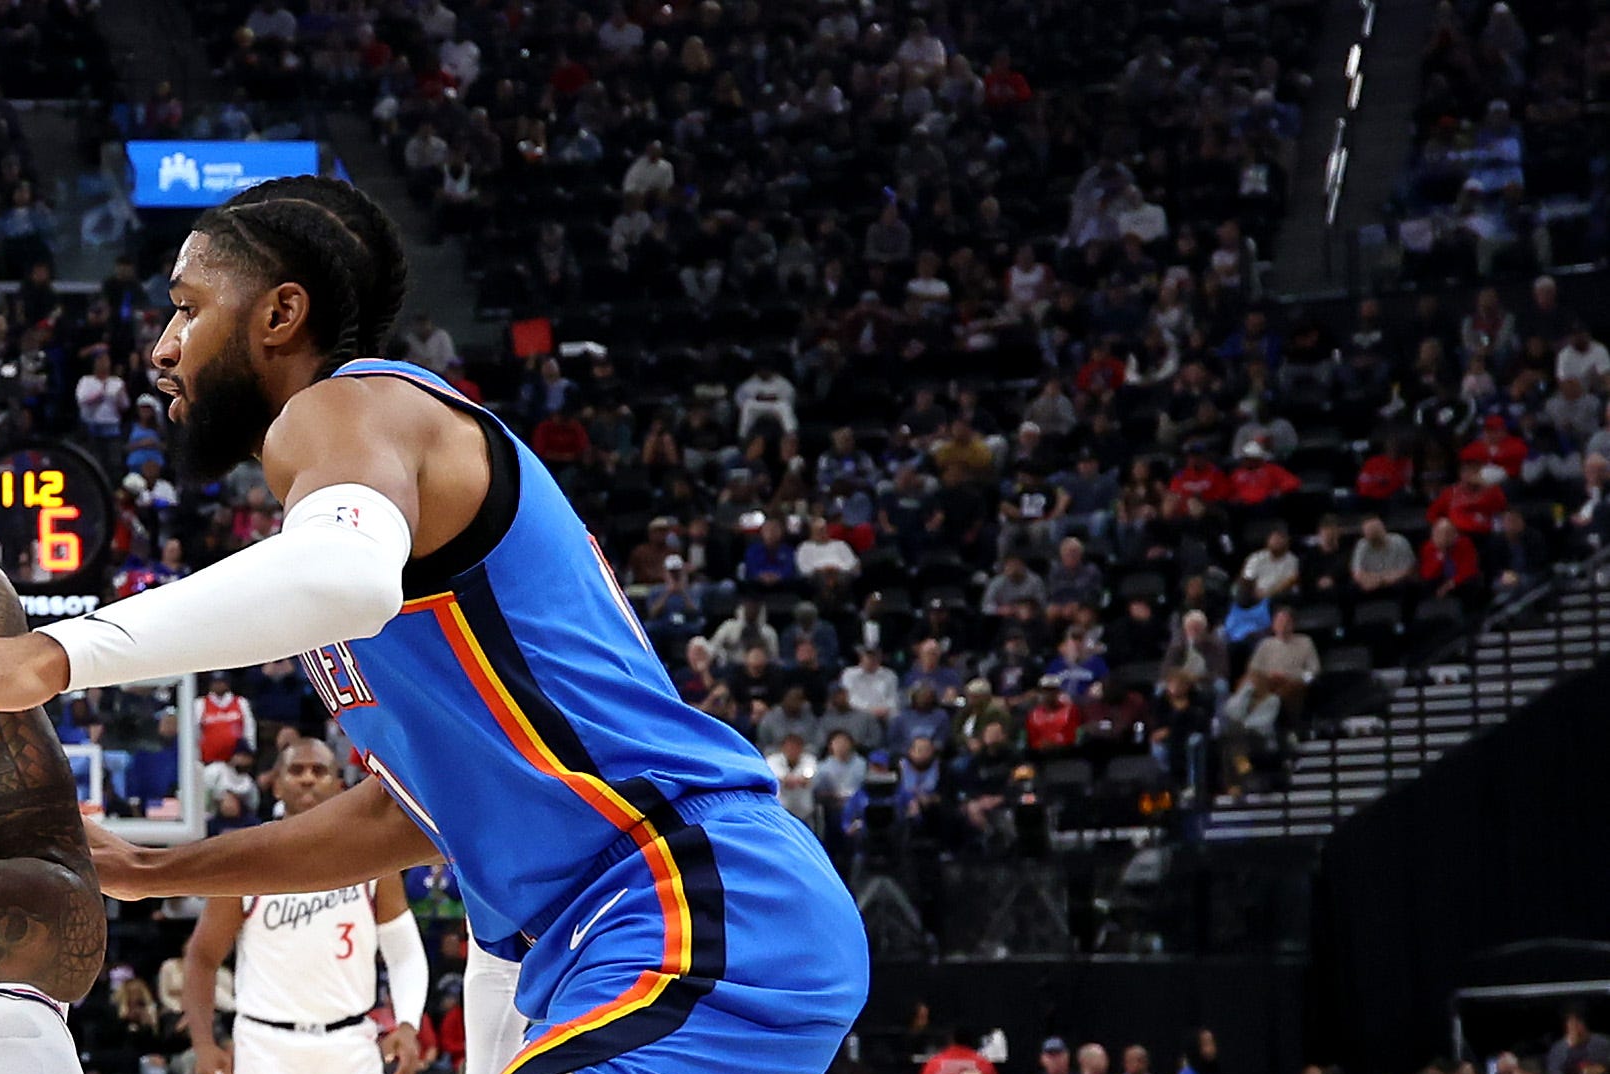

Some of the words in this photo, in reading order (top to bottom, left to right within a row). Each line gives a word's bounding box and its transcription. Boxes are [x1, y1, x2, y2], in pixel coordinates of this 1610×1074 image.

[39, 506, 82, 572] 6
[263, 886, 360, 931] Clippers
[335, 922, 355, 960] 3
